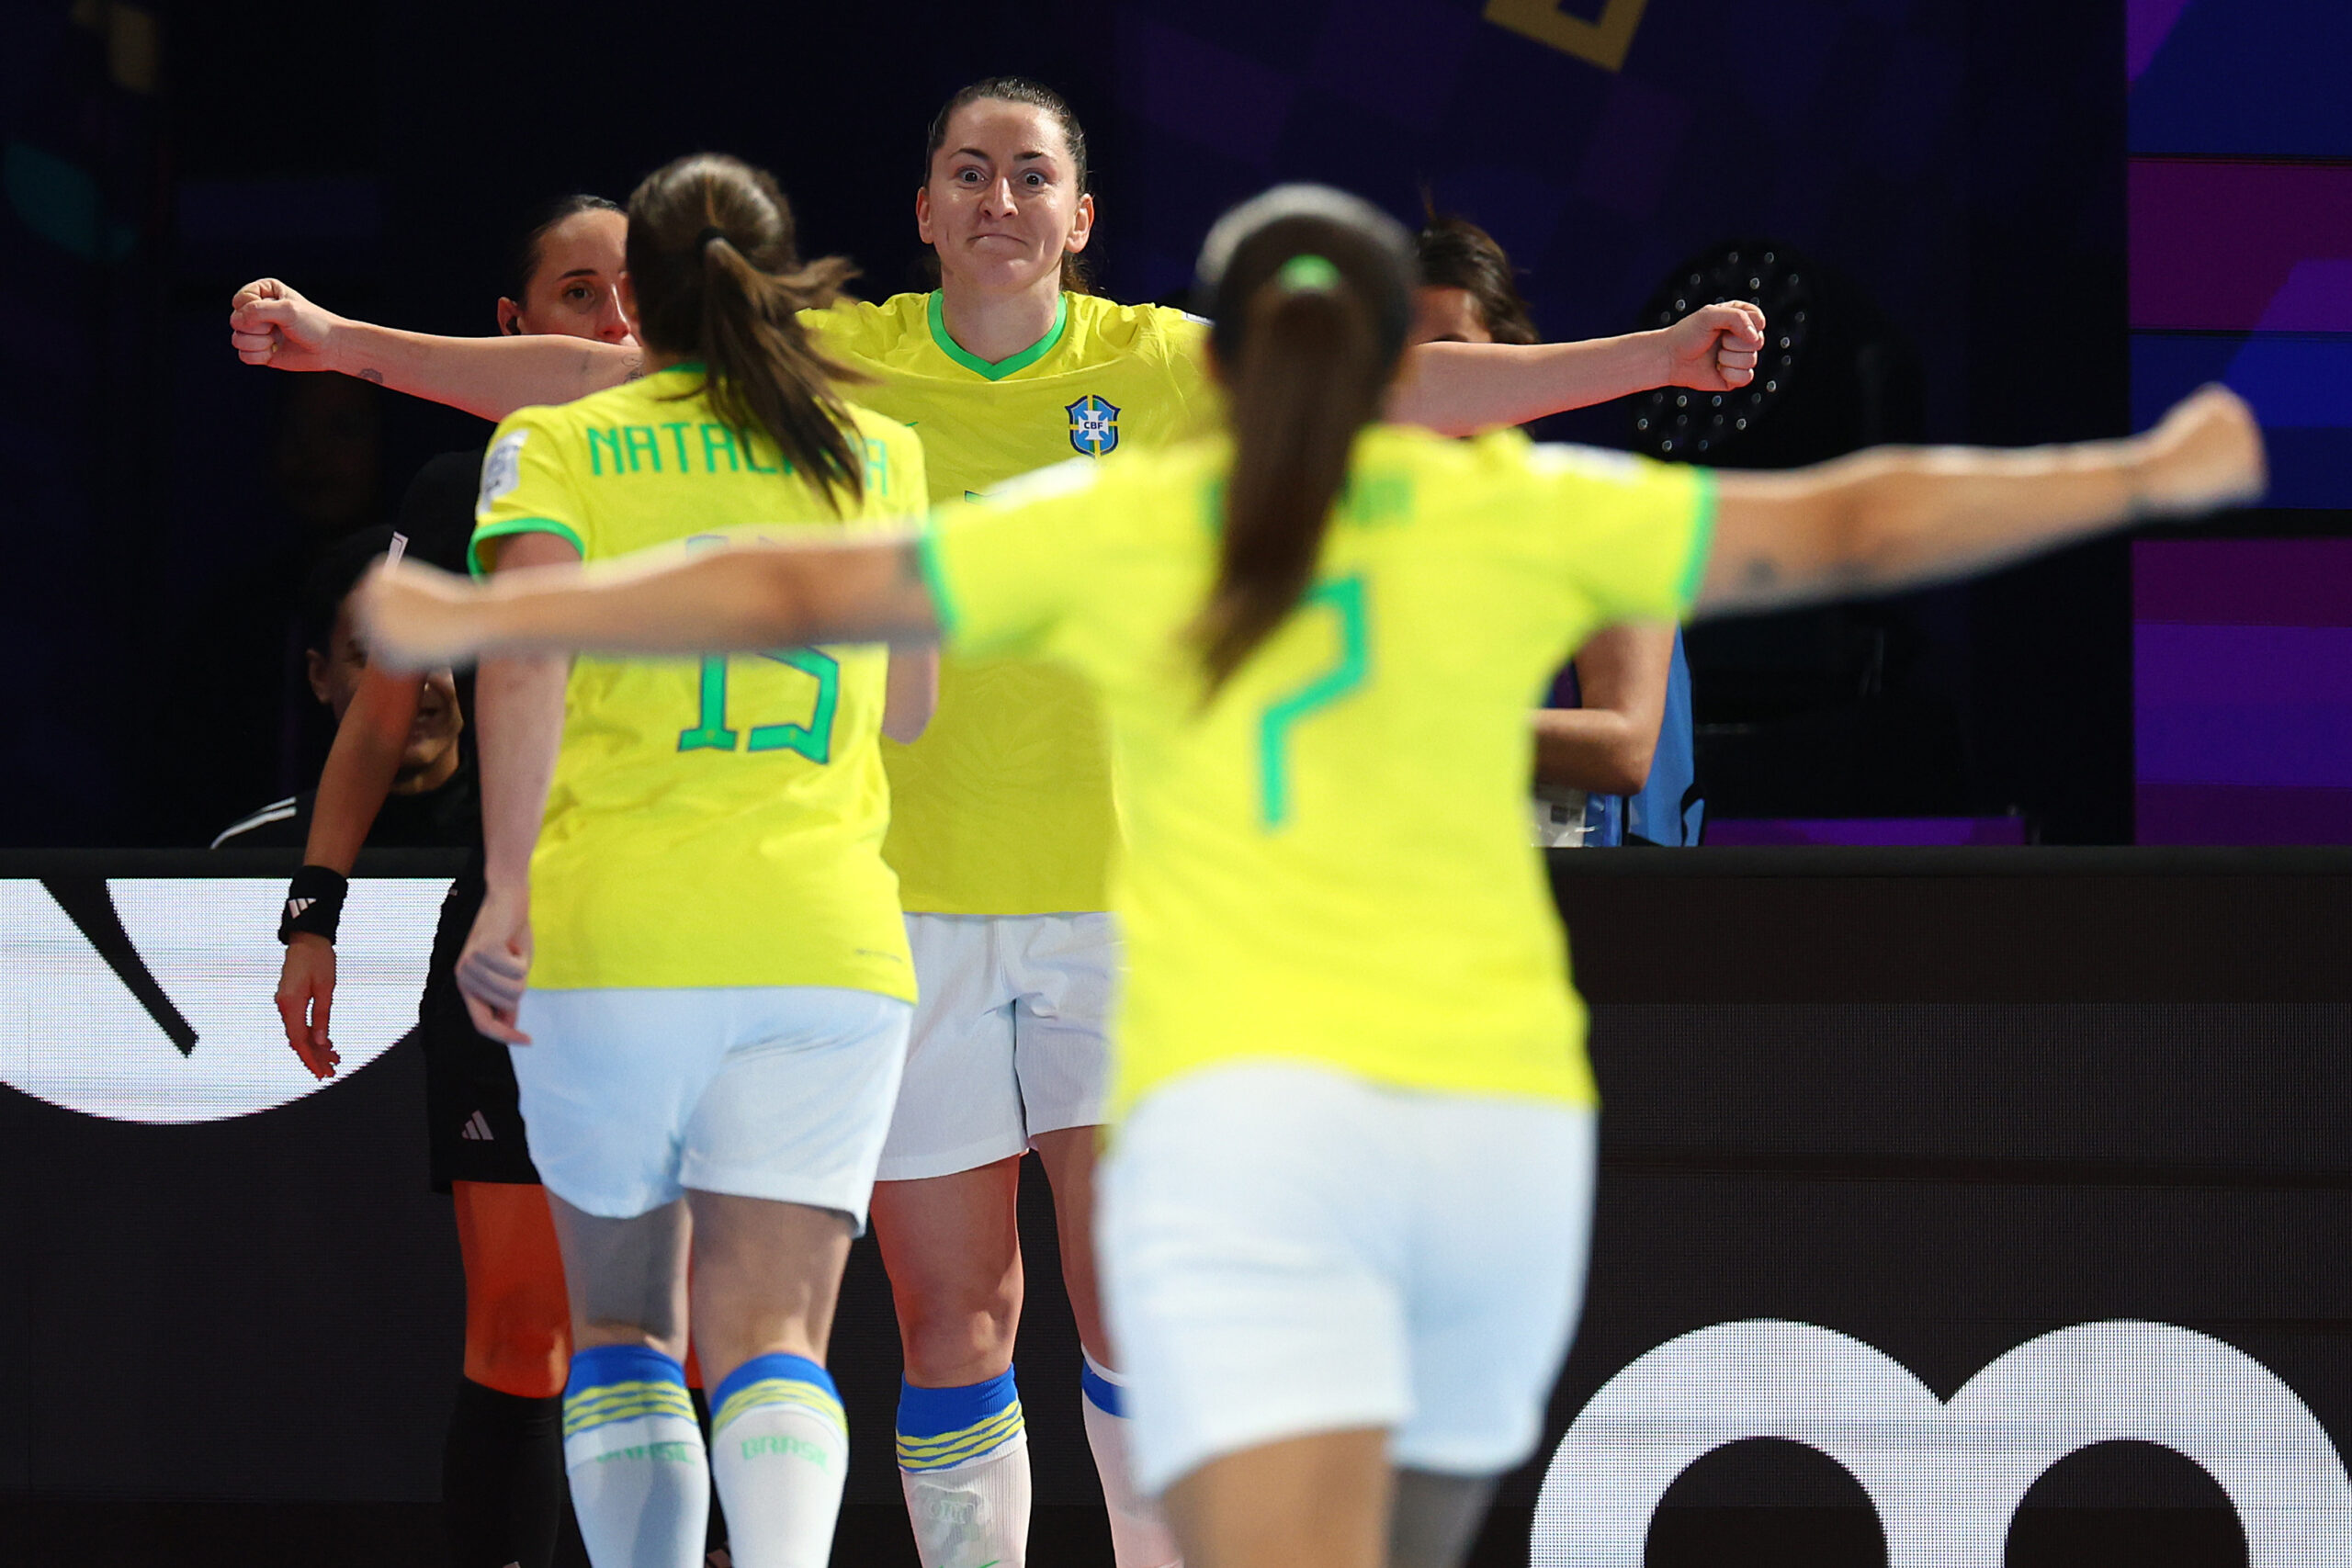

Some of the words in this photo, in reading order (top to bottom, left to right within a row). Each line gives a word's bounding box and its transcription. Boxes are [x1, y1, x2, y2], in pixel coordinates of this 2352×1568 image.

[587, 422, 888, 497] NATALA
[1083, 421, 1103, 430] CBF
[1259, 575, 1366, 826] 7
